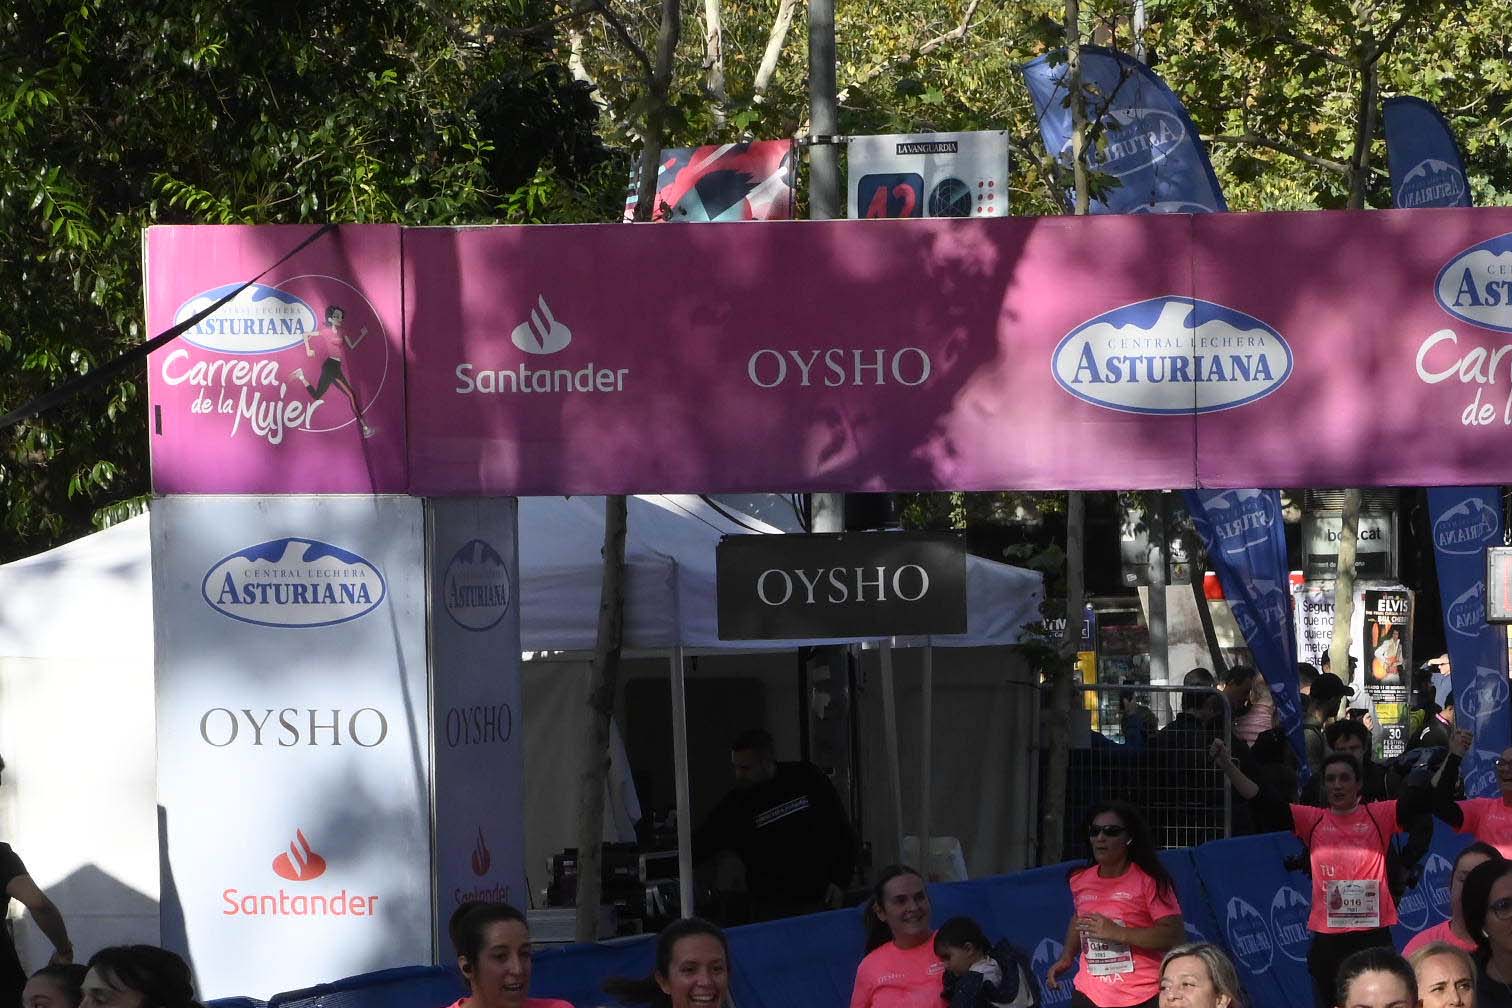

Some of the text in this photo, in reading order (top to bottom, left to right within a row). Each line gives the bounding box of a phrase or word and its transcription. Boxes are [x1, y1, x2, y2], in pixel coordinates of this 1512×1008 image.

[1107, 336, 1184, 350] CENTRAL
[161, 348, 281, 388] Carrera
[456, 362, 630, 395] Santander
[748, 347, 931, 388] OYSHO
[1071, 341, 1274, 385] ASTURIANA
[192, 382, 326, 445] de la Mujer
[1462, 388, 1495, 426] de
[216, 571, 373, 606] ASTURIANA
[244, 568, 367, 579] CENTRAL LECHERA
[757, 563, 930, 607] OYSHO
[1378, 599, 1409, 613] ELVIS
[199, 707, 389, 749] OYSHO
[446, 702, 513, 749] OYSHO
[1389, 729, 1401, 740] 30
[222, 888, 379, 918] Santander
